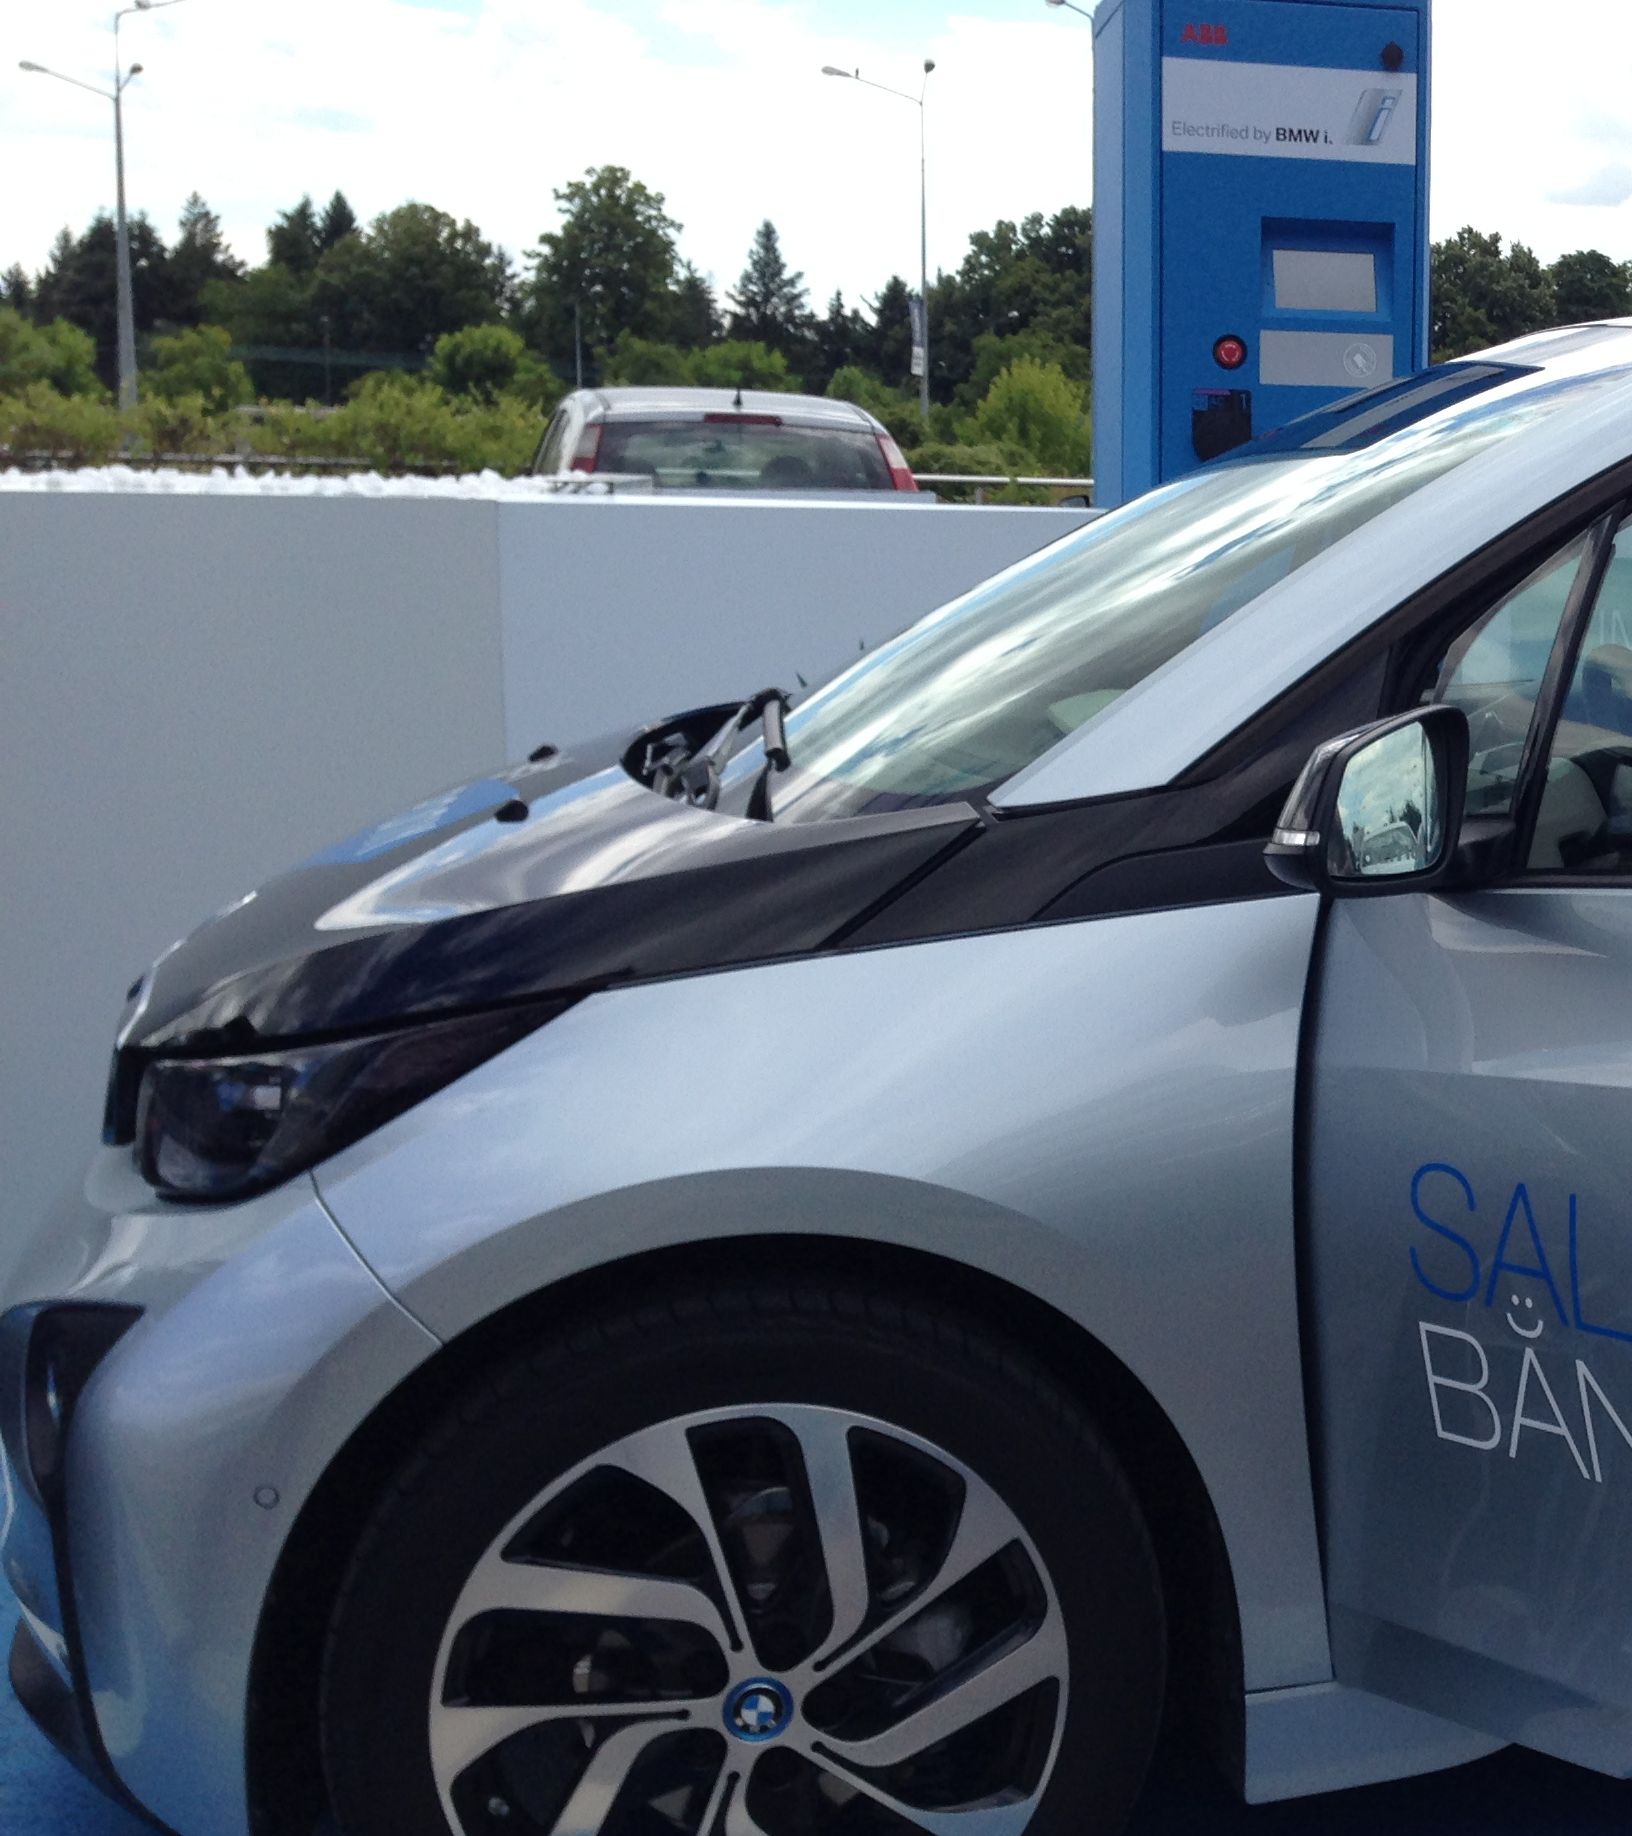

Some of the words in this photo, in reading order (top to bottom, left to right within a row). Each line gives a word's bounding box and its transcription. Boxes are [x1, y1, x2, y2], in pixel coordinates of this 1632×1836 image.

[1181, 22, 1229, 45] ABB
[1171, 120, 1249, 140] Electrified
[1253, 126, 1271, 143] by
[1275, 127, 1320, 143] BMW
